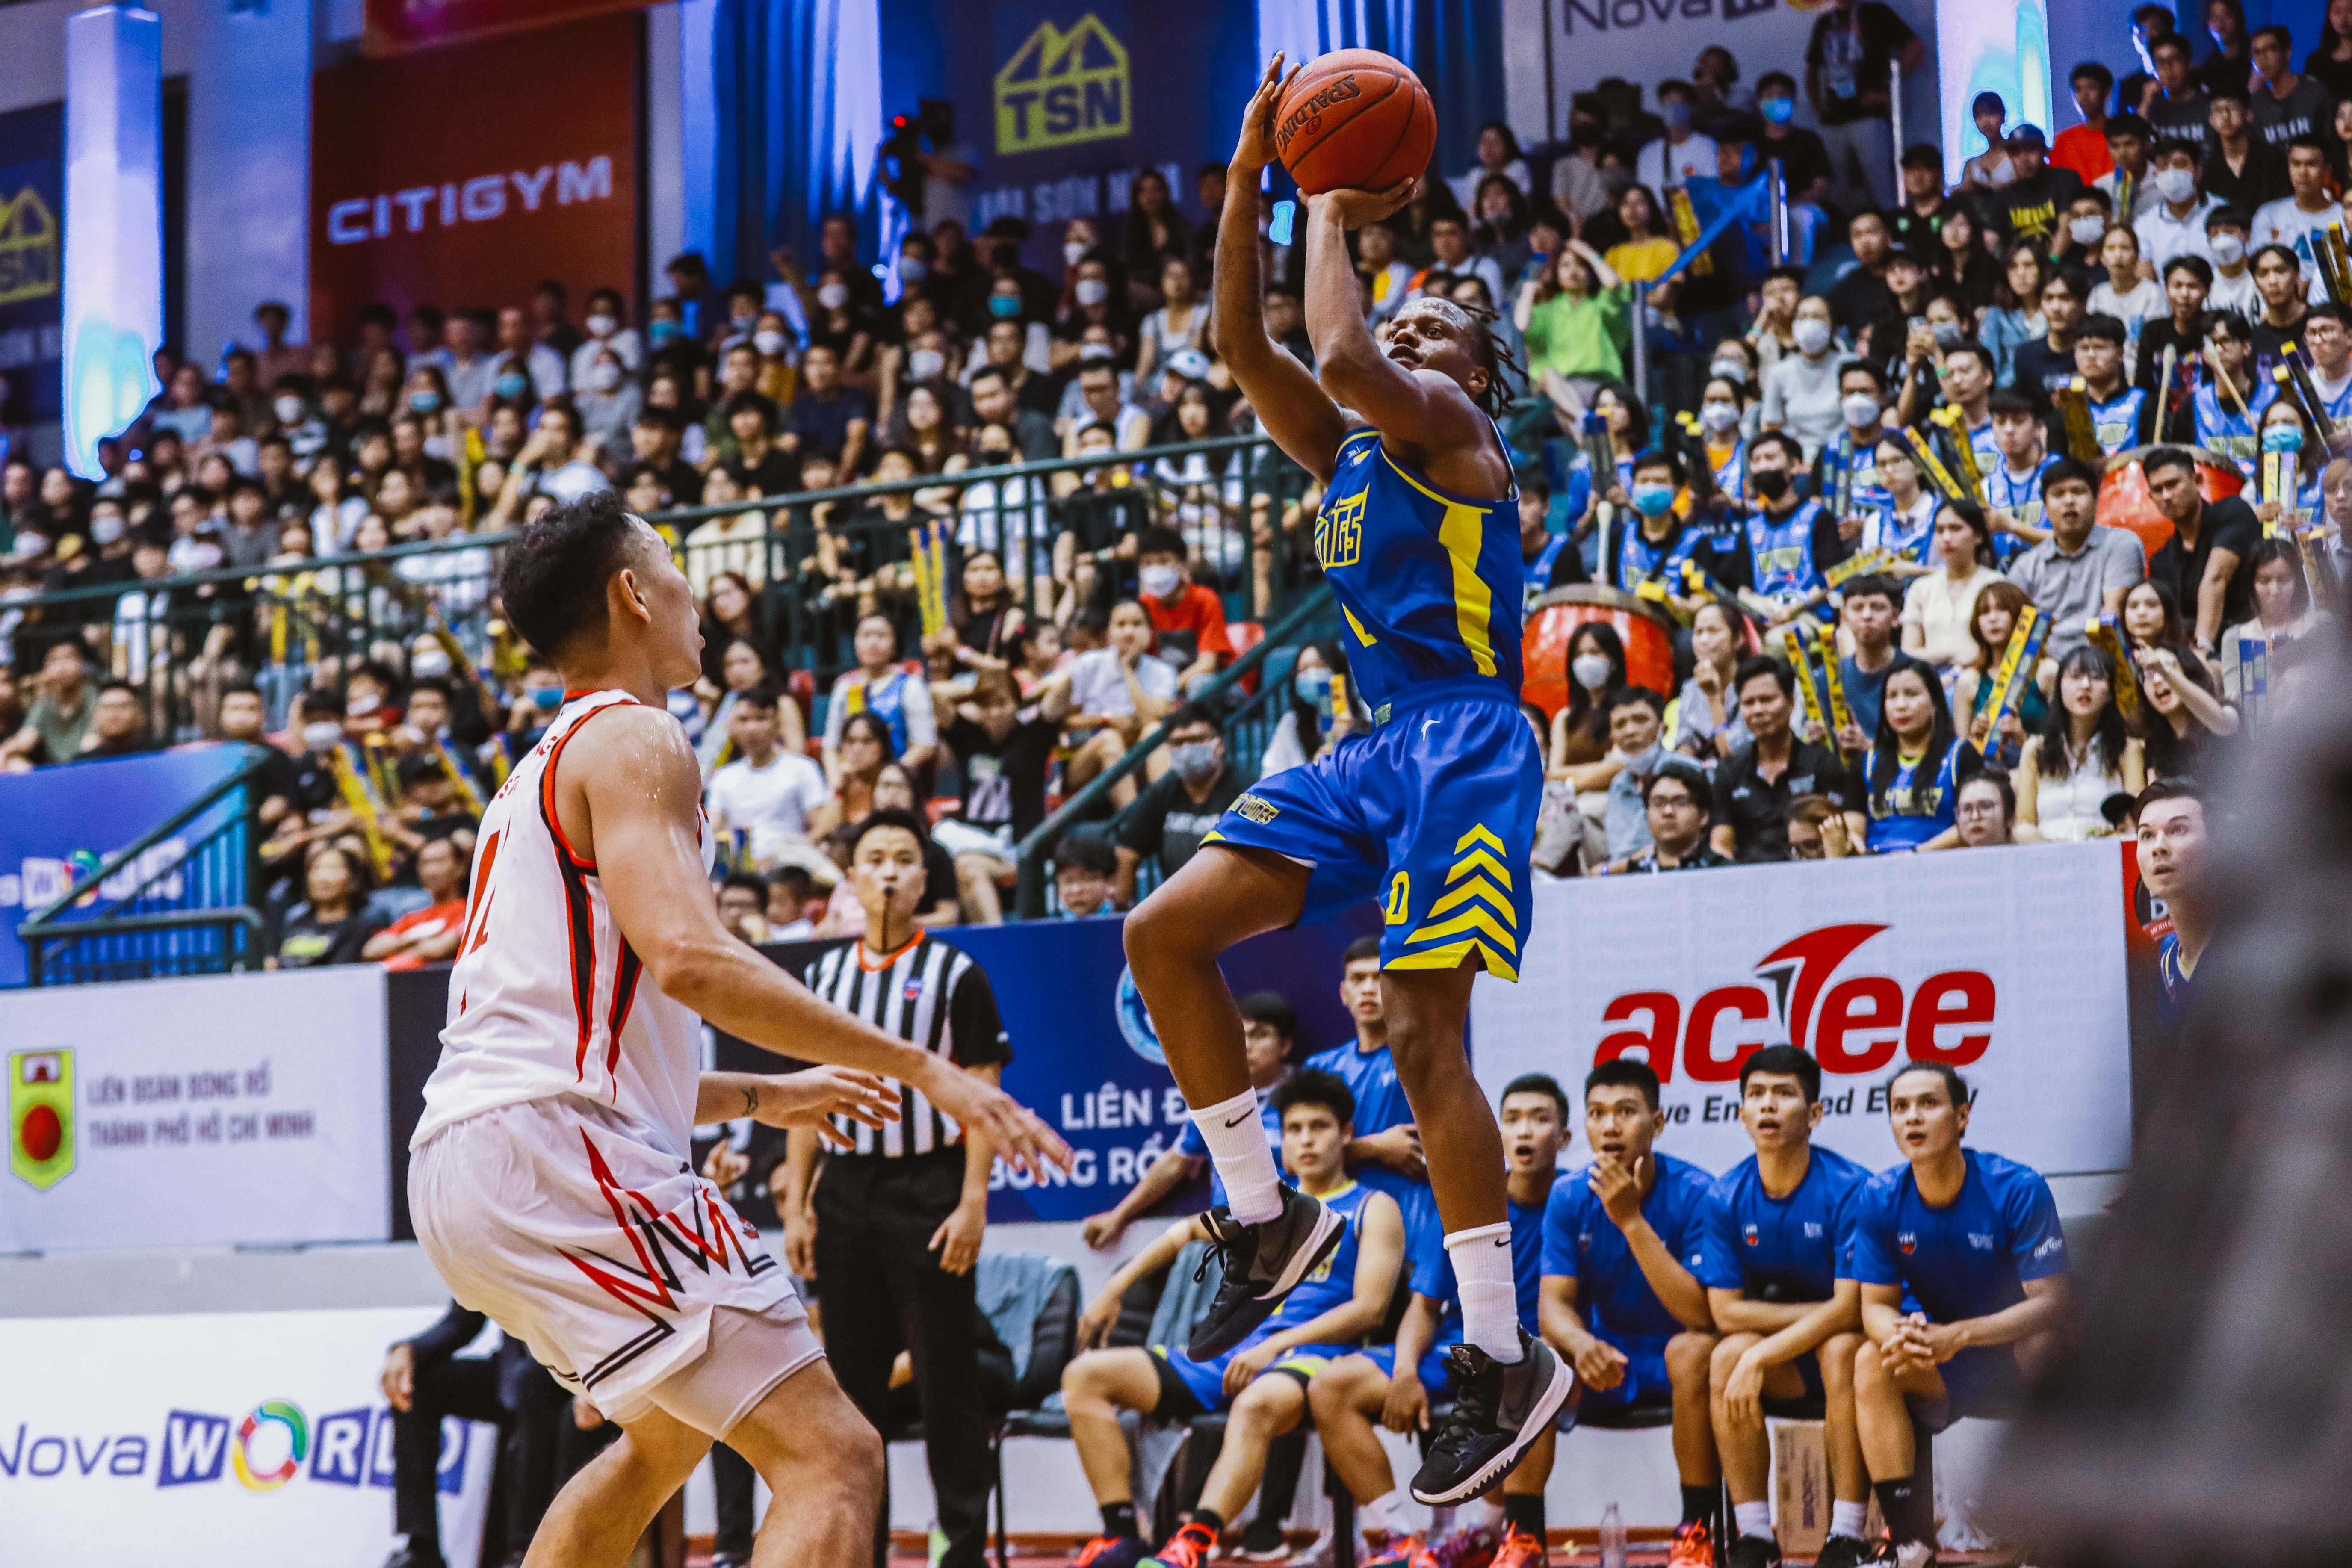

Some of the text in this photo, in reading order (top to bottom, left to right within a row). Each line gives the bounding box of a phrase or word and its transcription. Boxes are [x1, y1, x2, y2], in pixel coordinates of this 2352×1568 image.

[1004, 76, 1122, 140] TSN
[1276, 74, 1361, 154] SPALDING
[328, 154, 612, 245] CITIGYM
[1061, 1081, 1153, 1130] LIÊN
